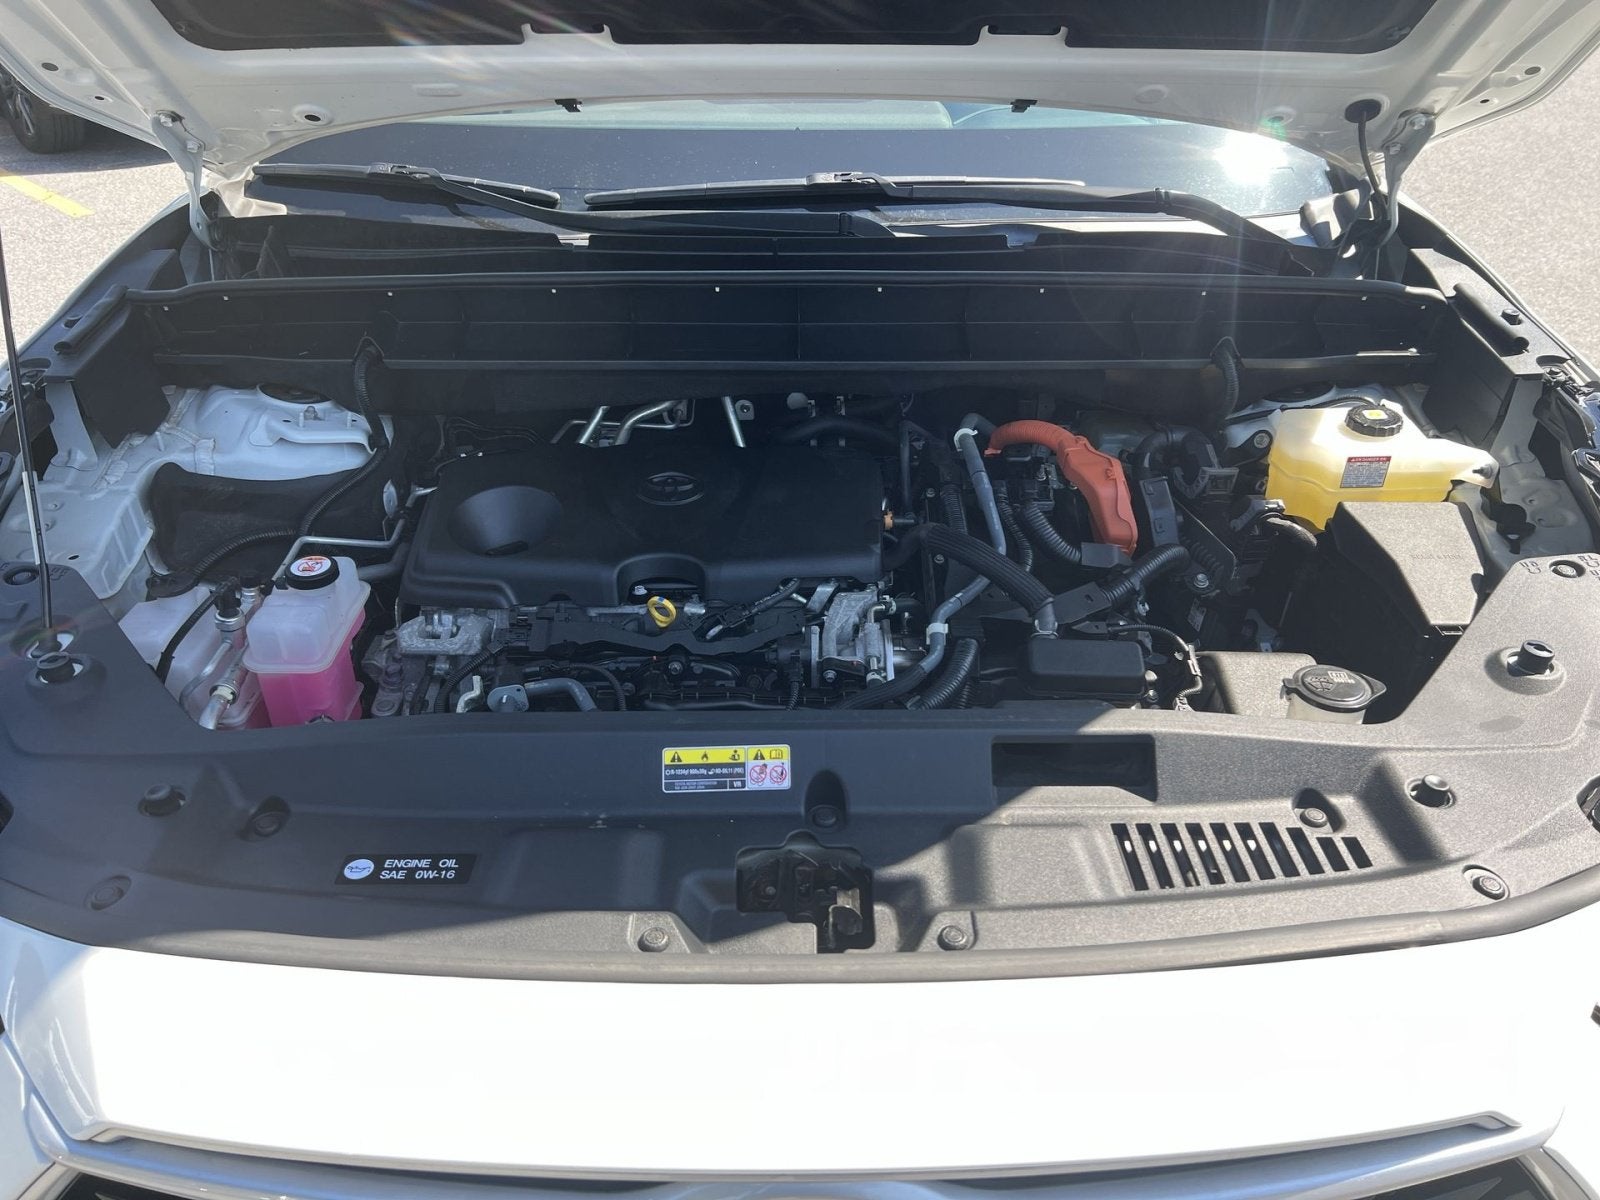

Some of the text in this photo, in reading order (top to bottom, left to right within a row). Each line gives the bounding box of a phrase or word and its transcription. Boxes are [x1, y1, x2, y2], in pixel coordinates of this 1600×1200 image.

[384, 858, 459, 868] ENGINE OIL
[380, 870, 455, 879] SAE 0W-16
